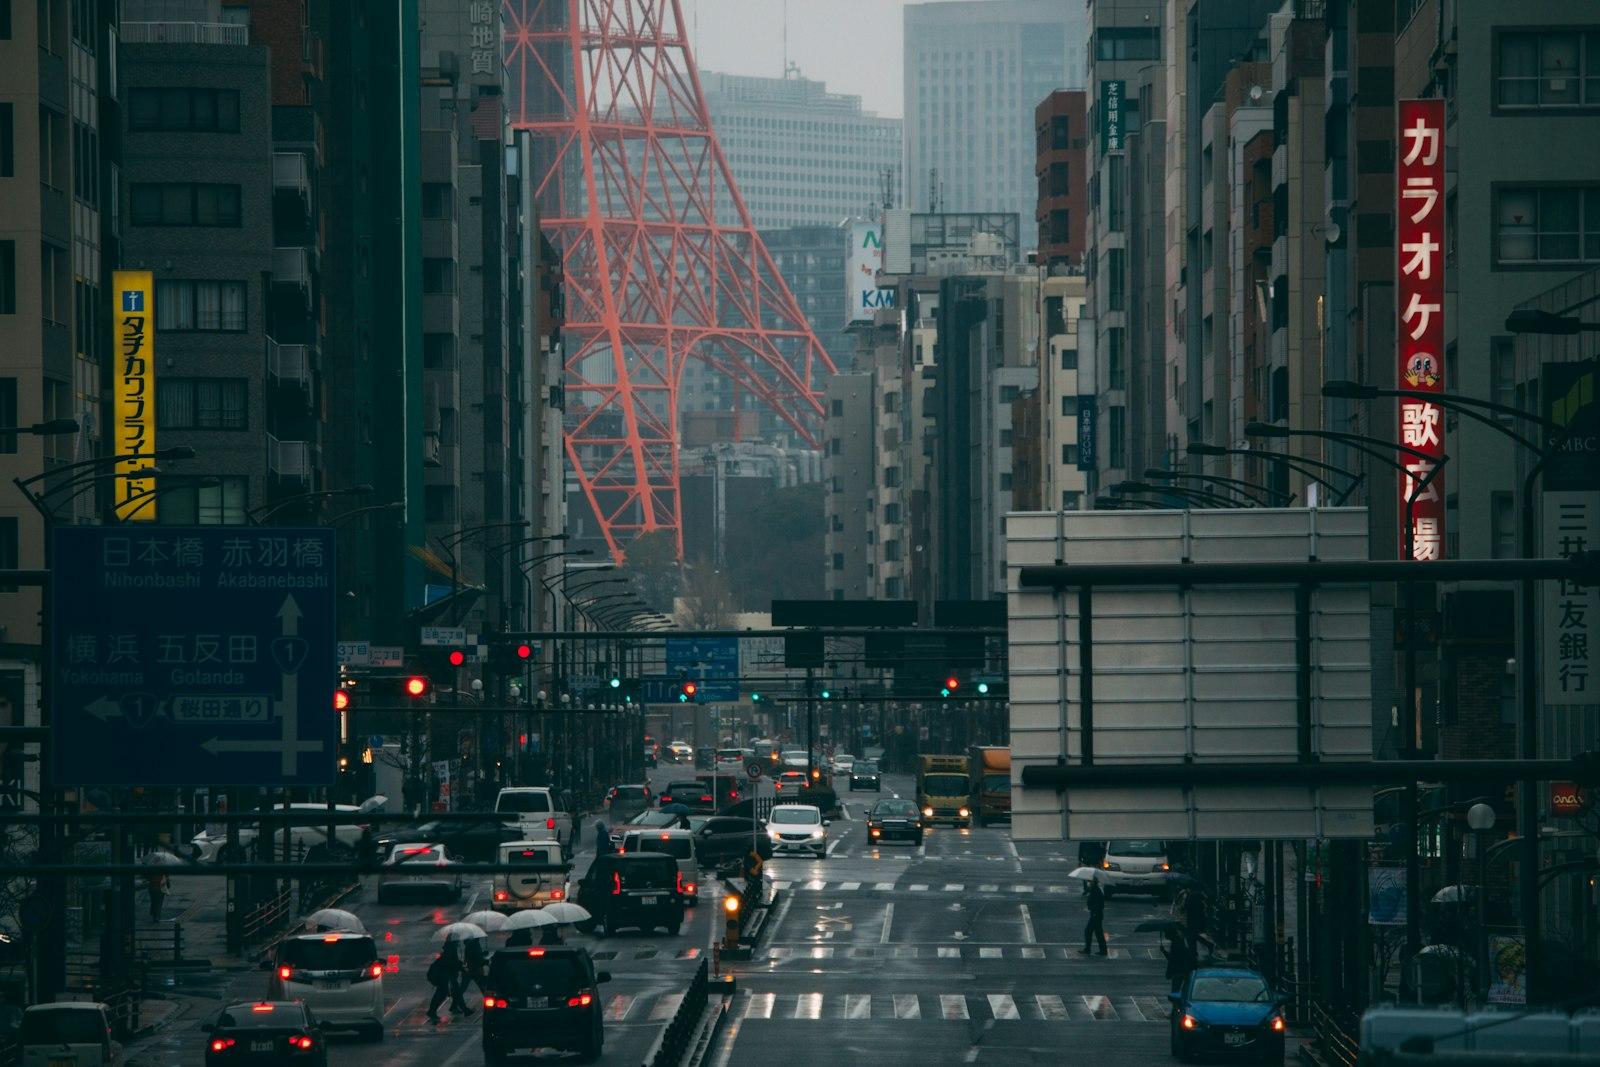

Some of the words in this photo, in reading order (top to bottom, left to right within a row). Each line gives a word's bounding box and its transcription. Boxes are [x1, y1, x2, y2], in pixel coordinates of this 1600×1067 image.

[470, 0, 494, 76] 崎地質
[1402, 118, 1441, 341] カラオケ
[1402, 402, 1441, 561] 歌広場
[103, 537, 204, 568] 日本橋
[221, 537, 324, 568] 赤羽橋
[104, 572, 201, 588] Nihonbashi
[217, 572, 328, 588] Akabanebashi
[1558, 504, 1589, 692] 三井住友銀行
[65, 634, 139, 664] 横浜
[156, 634, 257, 664] 五反田
[285, 642, 294, 662] 1
[61, 668, 143, 685] Yokohama
[171, 668, 245, 685] Gotanda
[180, 697, 262, 720] 桜田通り
